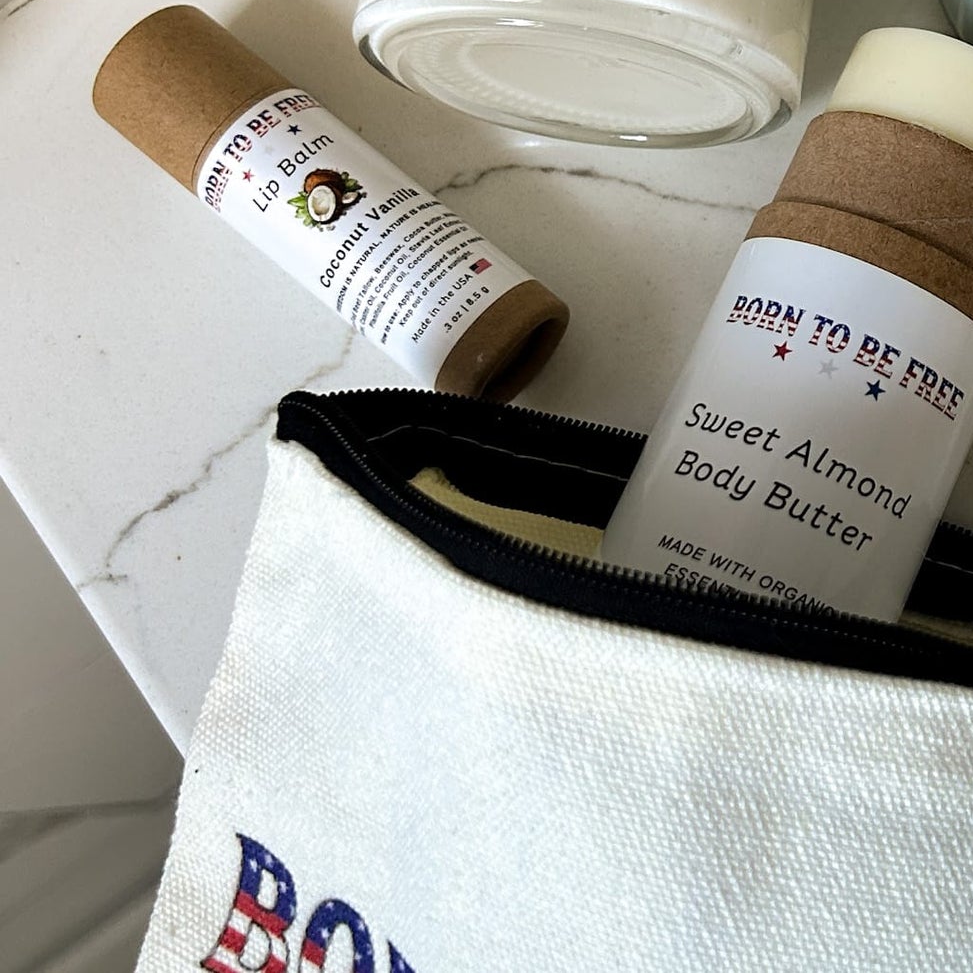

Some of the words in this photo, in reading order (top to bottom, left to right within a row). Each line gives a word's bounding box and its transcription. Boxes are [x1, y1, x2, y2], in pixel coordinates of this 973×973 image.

[223, 133, 252, 162] TO
[246, 109, 282, 138] BE
[252, 180, 280, 212] Lip
[277, 134, 334, 177] Balm
[319, 221, 369, 288] Coconut
[365, 188, 420, 220] Vanilla
[344, 276, 352, 285] IS
[350, 241, 383, 277] NATURAL,
[380, 213, 411, 239] NATURE
[407, 245, 436, 270] Coconut
[374, 264, 399, 294] Coconut
[398, 288, 415, 310] Apply
[412, 280, 421, 290] to
[421, 254, 448, 282] chapped
[399, 308, 414, 328] Keep
[411, 295, 424, 309] out
[428, 269, 449, 288] direct
[411, 318, 433, 345] Made
[430, 307, 440, 318] in
[438, 290, 455, 307] the
[452, 273, 474, 290] USA
[451, 310, 463, 323] oz
[726, 294, 806, 338] BORN
[809, 313, 852, 355] TO
[853, 333, 902, 380] BE
[899, 356, 965, 421] FREE
[685, 402, 781, 452] Sweet
[785, 438, 913, 520] Almond
[674, 449, 757, 502] Body
[763, 480, 874, 553] Butter
[658, 534, 707, 561] MADE
[709, 552, 757, 582] WITH
[199, 832, 417, 973] BO
